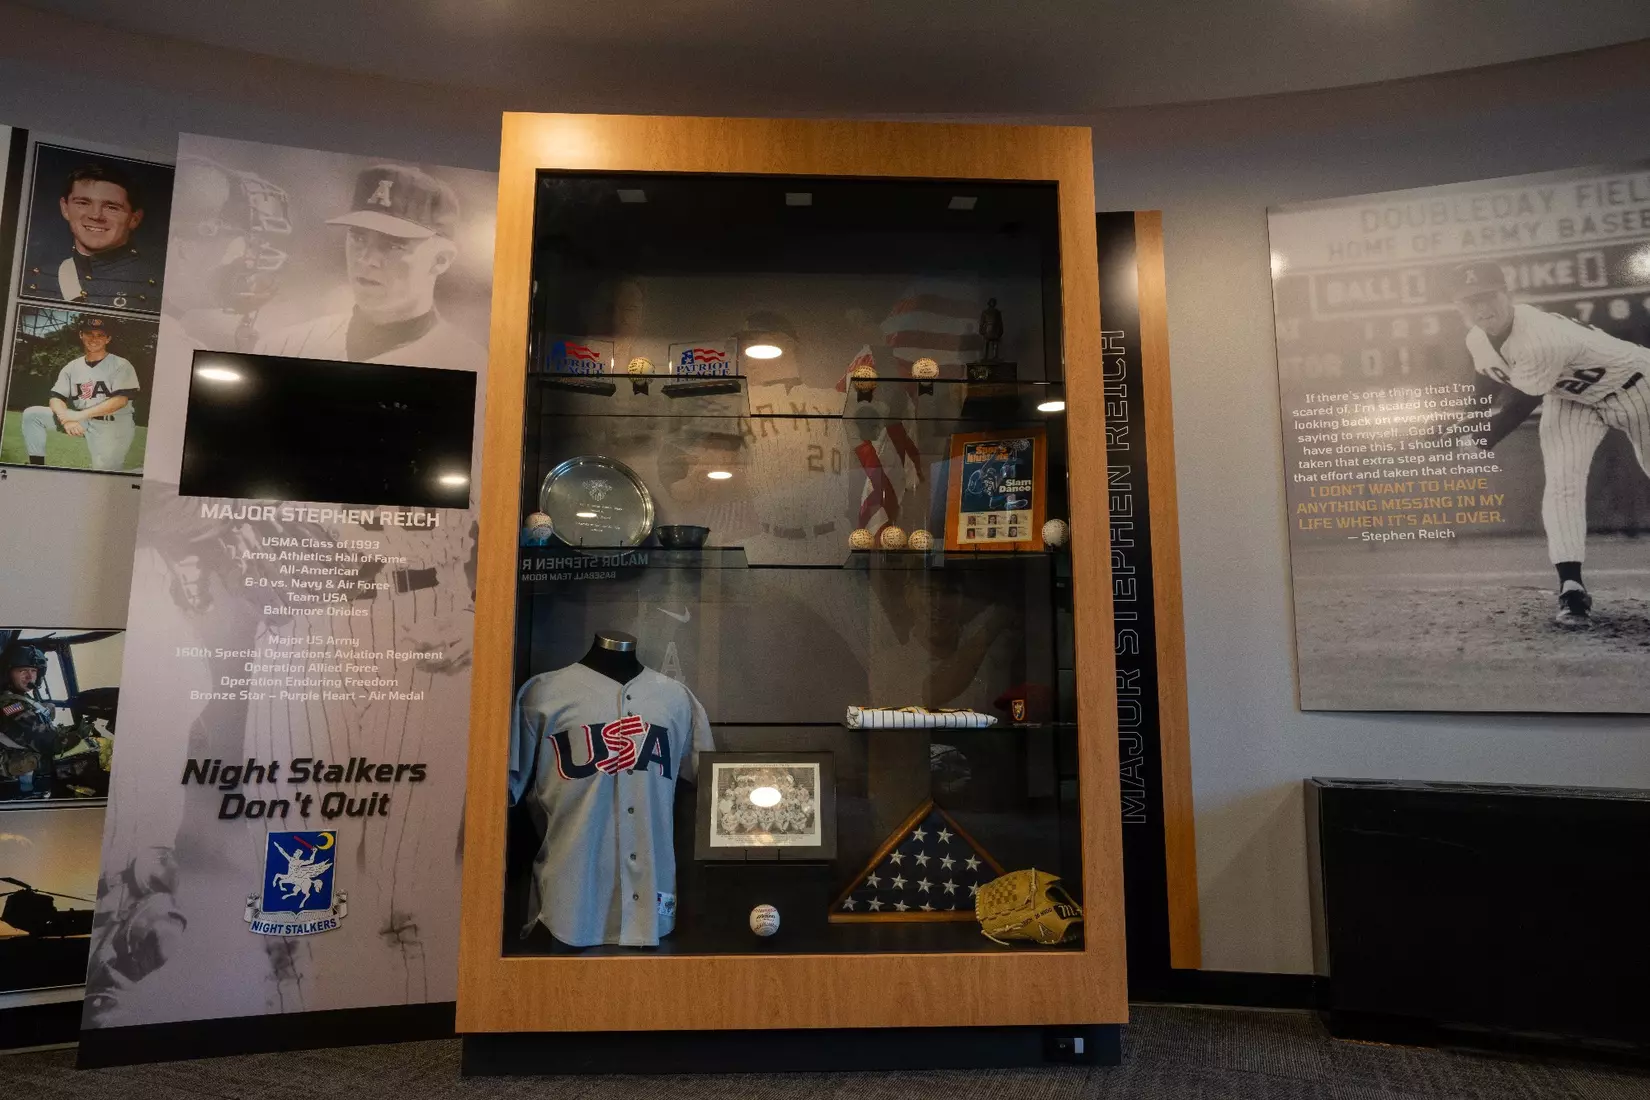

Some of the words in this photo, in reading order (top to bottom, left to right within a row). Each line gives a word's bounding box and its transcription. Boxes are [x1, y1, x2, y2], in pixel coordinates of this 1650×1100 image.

[367, 180, 394, 207] A
[1576, 174, 1650, 208] FIEL
[677, 361, 731, 372] PATRIOT
[1556, 367, 1606, 394] 20
[1101, 329, 1130, 452] REICH
[1306, 393, 1316, 403] If
[1317, 390, 1359, 402] there's
[1363, 388, 1385, 400] one
[1389, 385, 1422, 399] thing
[1425, 383, 1450, 394] that
[1453, 383, 1475, 393] I'm
[1293, 404, 1332, 416] scared
[1354, 402, 1375, 413] I'm
[1378, 400, 1420, 411] scared
[1424, 399, 1436, 408] to
[1439, 396, 1476, 407] death
[1480, 394, 1492, 404] of
[1295, 418, 1339, 430] looking
[1342, 415, 1370, 427] back
[1376, 415, 1391, 426] on
[1394, 410, 1464, 424] everything
[1466, 409, 1492, 419] and
[1298, 432, 1338, 444] saying
[1341, 430, 1352, 440] to
[1438, 425, 1442, 434] I
[1446, 422, 1491, 433] should
[1303, 445, 1333, 455] have
[1336, 443, 1367, 454] done
[1370, 441, 1396, 452] this,
[1400, 440, 1404, 450] I
[1408, 438, 1452, 450] should
[1456, 436, 1487, 447] have
[807, 444, 842, 475] 20
[1299, 458, 1332, 469] taken
[1335, 456, 1359, 467] that
[1363, 455, 1394, 466] extra
[1398, 453, 1425, 465] step
[1429, 452, 1453, 462] and
[1457, 450, 1495, 461] made
[1294, 473, 1318, 482] that
[1321, 470, 1353, 481] effort
[1356, 469, 1380, 480] and
[1383, 466, 1418, 478] taken
[1422, 465, 1447, 476] that
[1450, 463, 1503, 474] chance.
[1310, 486, 1316, 498] I
[1319, 484, 1364, 497] DON'T
[1368, 481, 1414, 494] WANT
[1421, 481, 1440, 492] TO
[1444, 478, 1488, 491] HAVE
[1297, 499, 1377, 515] ANYTHING
[1382, 496, 1453, 511] MISSING
[1457, 495, 1475, 506] IN
[1480, 494, 1505, 506] MY
[201, 503, 276, 522] MAJOR
[282, 508, 374, 525] STEPHEN
[380, 511, 440, 527] REICH
[1299, 518, 1332, 530] LIFE
[1336, 515, 1383, 528] WHEN
[1388, 513, 1417, 526] IT'S
[1422, 512, 1452, 525] ALL
[1456, 511, 1506, 524] OVER.
[262, 537, 298, 547] USMA
[302, 538, 333, 548] Class
[337, 538, 349, 548] of
[351, 539, 379, 549] 1993
[1362, 530, 1415, 543] Stephen
[1418, 528, 1455, 539] Reich
[242, 550, 277, 562] Army
[280, 551, 332, 562] Athletics
[336, 553, 359, 563] Hall
[361, 553, 372, 563] of
[374, 554, 406, 564] Fame
[1107, 465, 1139, 655] STEPHEN
[279, 565, 359, 576] All-American
[245, 578, 267, 588] 6-0
[291, 579, 322, 590] Navy
[325, 580, 334, 589] &
[338, 580, 354, 589] Air
[358, 581, 390, 590] Force
[286, 592, 319, 602] Team
[323, 593, 348, 602] USA
[263, 605, 323, 616] Baltimore
[327, 606, 368, 617] Orioles
[268, 635, 304, 646] Major
[307, 635, 323, 645] US
[326, 636, 360, 647] Army
[176, 647, 211, 658] 160th
[215, 648, 261, 660] Special
[264, 648, 331, 661] Operations
[335, 649, 383, 660] Aviation
[386, 650, 443, 662] Regiment
[244, 662, 305, 674] Operation
[309, 663, 342, 673] Allied
[346, 663, 378, 674] Force
[220, 676, 282, 689] Operation
[286, 677, 341, 689] Enduring
[345, 677, 398, 687] Freedom
[190, 690, 237, 701] Bronze
[239, 690, 265, 700] Star
[279, 691, 320, 702] Purple
[323, 691, 356, 701] Heart
[368, 691, 386, 701] Air
[389, 691, 424, 701] Medal
[548, 715, 672, 780] USA
[1114, 669, 1147, 824] MAJOR
[182, 758, 281, 790] Night
[288, 758, 427, 784] Stalkers
[218, 793, 313, 819] Don't
[321, 792, 391, 820] Quit
[251, 921, 284, 934] NIGHT
[285, 918, 336, 934] STALKERS
